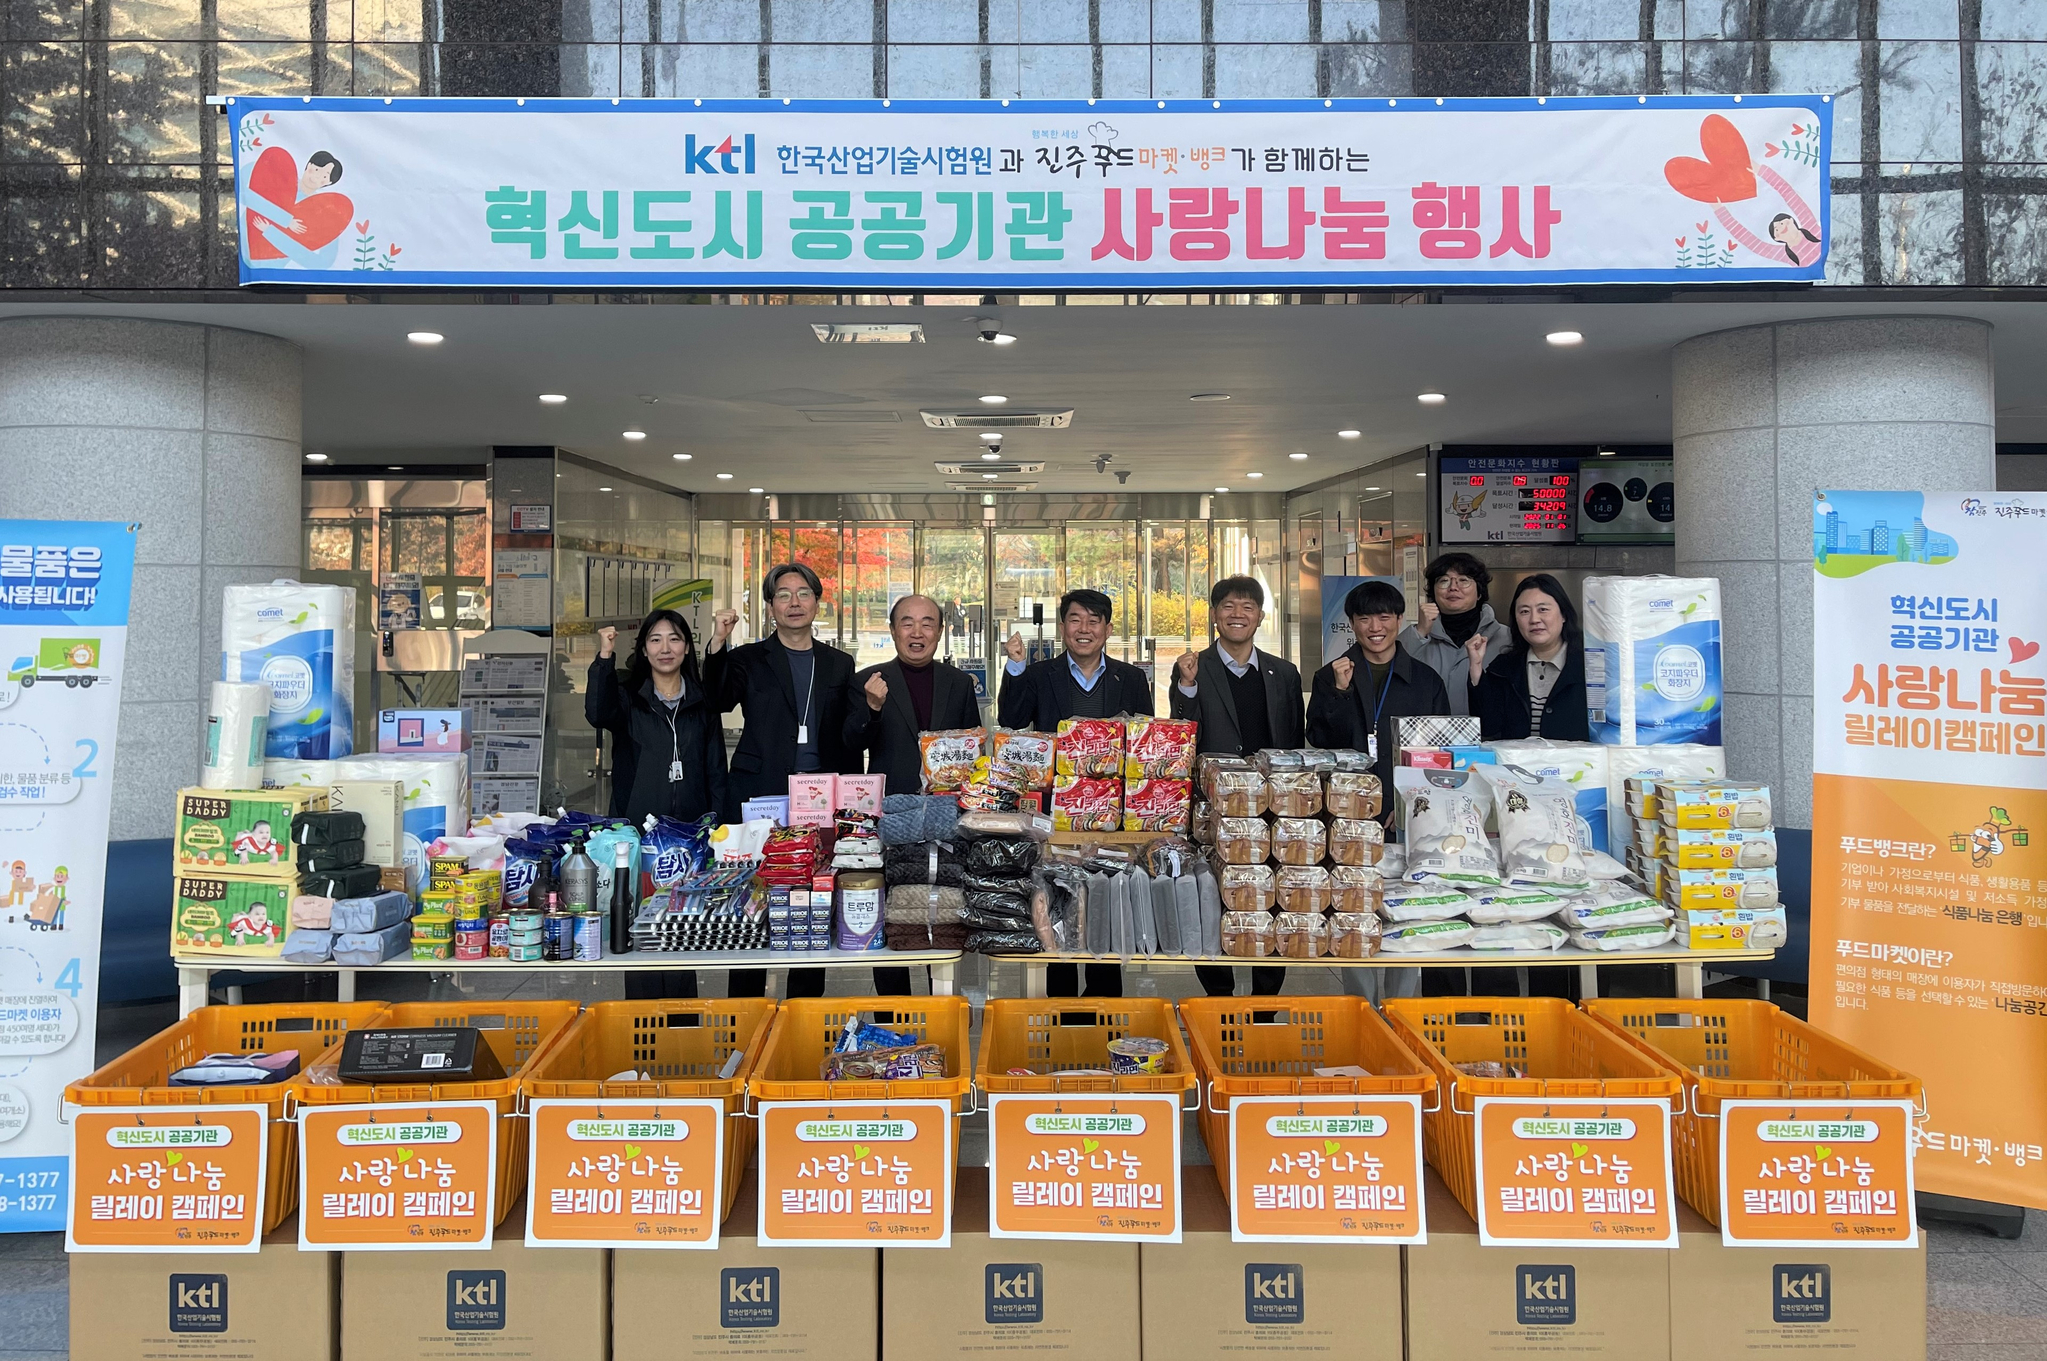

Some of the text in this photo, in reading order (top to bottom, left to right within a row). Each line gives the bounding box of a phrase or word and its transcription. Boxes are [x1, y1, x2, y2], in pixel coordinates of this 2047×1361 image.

[1031, 128, 1079, 140] 행복한 세상
[685, 133, 756, 175] ktl
[777, 144, 992, 176] 한국산업기술시험원
[1264, 147, 1369, 173] 함께하는
[484, 181, 1563, 262] 혁신도시 공공기관 사랑나눔 행사
[1552, 475, 1570, 486] 100
[1533, 488, 1566, 499] 50000
[1533, 501, 1567, 511] 34209
[1594, 504, 1613, 512] 14.8
[1487, 530, 1504, 540] ktl
[0, 544, 102, 578] 물품은
[257, 607, 284, 617] comet
[1648, 599, 1674, 608] comet
[1890, 594, 1998, 622] 혁신도시
[1890, 624, 1999, 653] 공공기관
[1660, 668, 1698, 679] 코지파우더
[1667, 678, 1691, 688] 화장지
[273, 690, 298, 700] 화장지
[1842, 663, 2047, 716] 사랑나눔
[1654, 717, 1665, 726] 30
[1844, 713, 2046, 757] 릴레이캠페인
[72, 738, 99, 778] 2
[17, 773, 72, 785] 물품 분류 등
[797, 778, 828, 786] secretday
[844, 779, 875, 787] secretday
[1535, 766, 1560, 777] comet
[186, 807, 227, 817] DADDY
[188, 798, 227, 809] SUPER
[1839, 836, 1937, 861] 푸드뱅크란?
[434, 862, 459, 871] SPAM
[1840, 862, 1884, 877] 기업이나
[1889, 866, 1956, 884] 가정으로부터
[1958, 873, 1984, 888] 식품,
[1986, 875, 2032, 892] 생활용품
[182, 888, 223, 899] DADDY
[184, 880, 223, 891] SUPER
[1840, 878, 2047, 910] 기부 받아 사회복지시설 및 저소득 가정
[1840, 896, 1861, 909] 기부
[1863, 899, 1894, 914] 물품을
[1896, 902, 1938, 918] 전달하는
[1835, 939, 1954, 968] 푸드마켓이란?
[54, 958, 83, 998] 4
[1835, 963, 1986, 992] 편의점 형태의 매장에 이용자가
[1835, 979, 1989, 1009] 필요한 식품 등을 선택할 수 있는
[1835, 995, 1869, 1011] 입니다.
[30, 1008, 62, 1021] 이용자
[12, 1035, 20, 1044] 수
[21, 1034, 42, 1044] 있도록
[1034, 1117, 1133, 1131] 혁신도시 공공기관
[1276, 1119, 1374, 1133] 혁신도시 공공기관
[1522, 1121, 1622, 1136] 혁신도시 공공기관
[117, 1130, 218, 1144] 혁신도시 공공기관
[92, 1195, 244, 1219] 릴레이 캠페인
[323, 1192, 474, 1217] 릴레이 캠페인
[551, 1189, 701, 1214] 릴레이 캠페인
[782, 1189, 931, 1213] 릴레이 캠페인
[1013, 1182, 1162, 1208] 릴레이 캠페인
[1254, 1185, 1405, 1210] 릴레이 캠페인
[1501, 1187, 1655, 1213] 릴레이 캠페인
[1744, 1190, 1896, 1214] 릴레이 캠페인
[178, 1283, 219, 1308] ktl
[456, 1279, 496, 1304] ktl
[730, 1277, 770, 1303] ktl
[994, 1272, 1034, 1298] ktl
[1254, 1273, 1294, 1298] ktl
[1525, 1274, 1566, 1299] ktl
[1782, 1273, 1822, 1298] ktl
